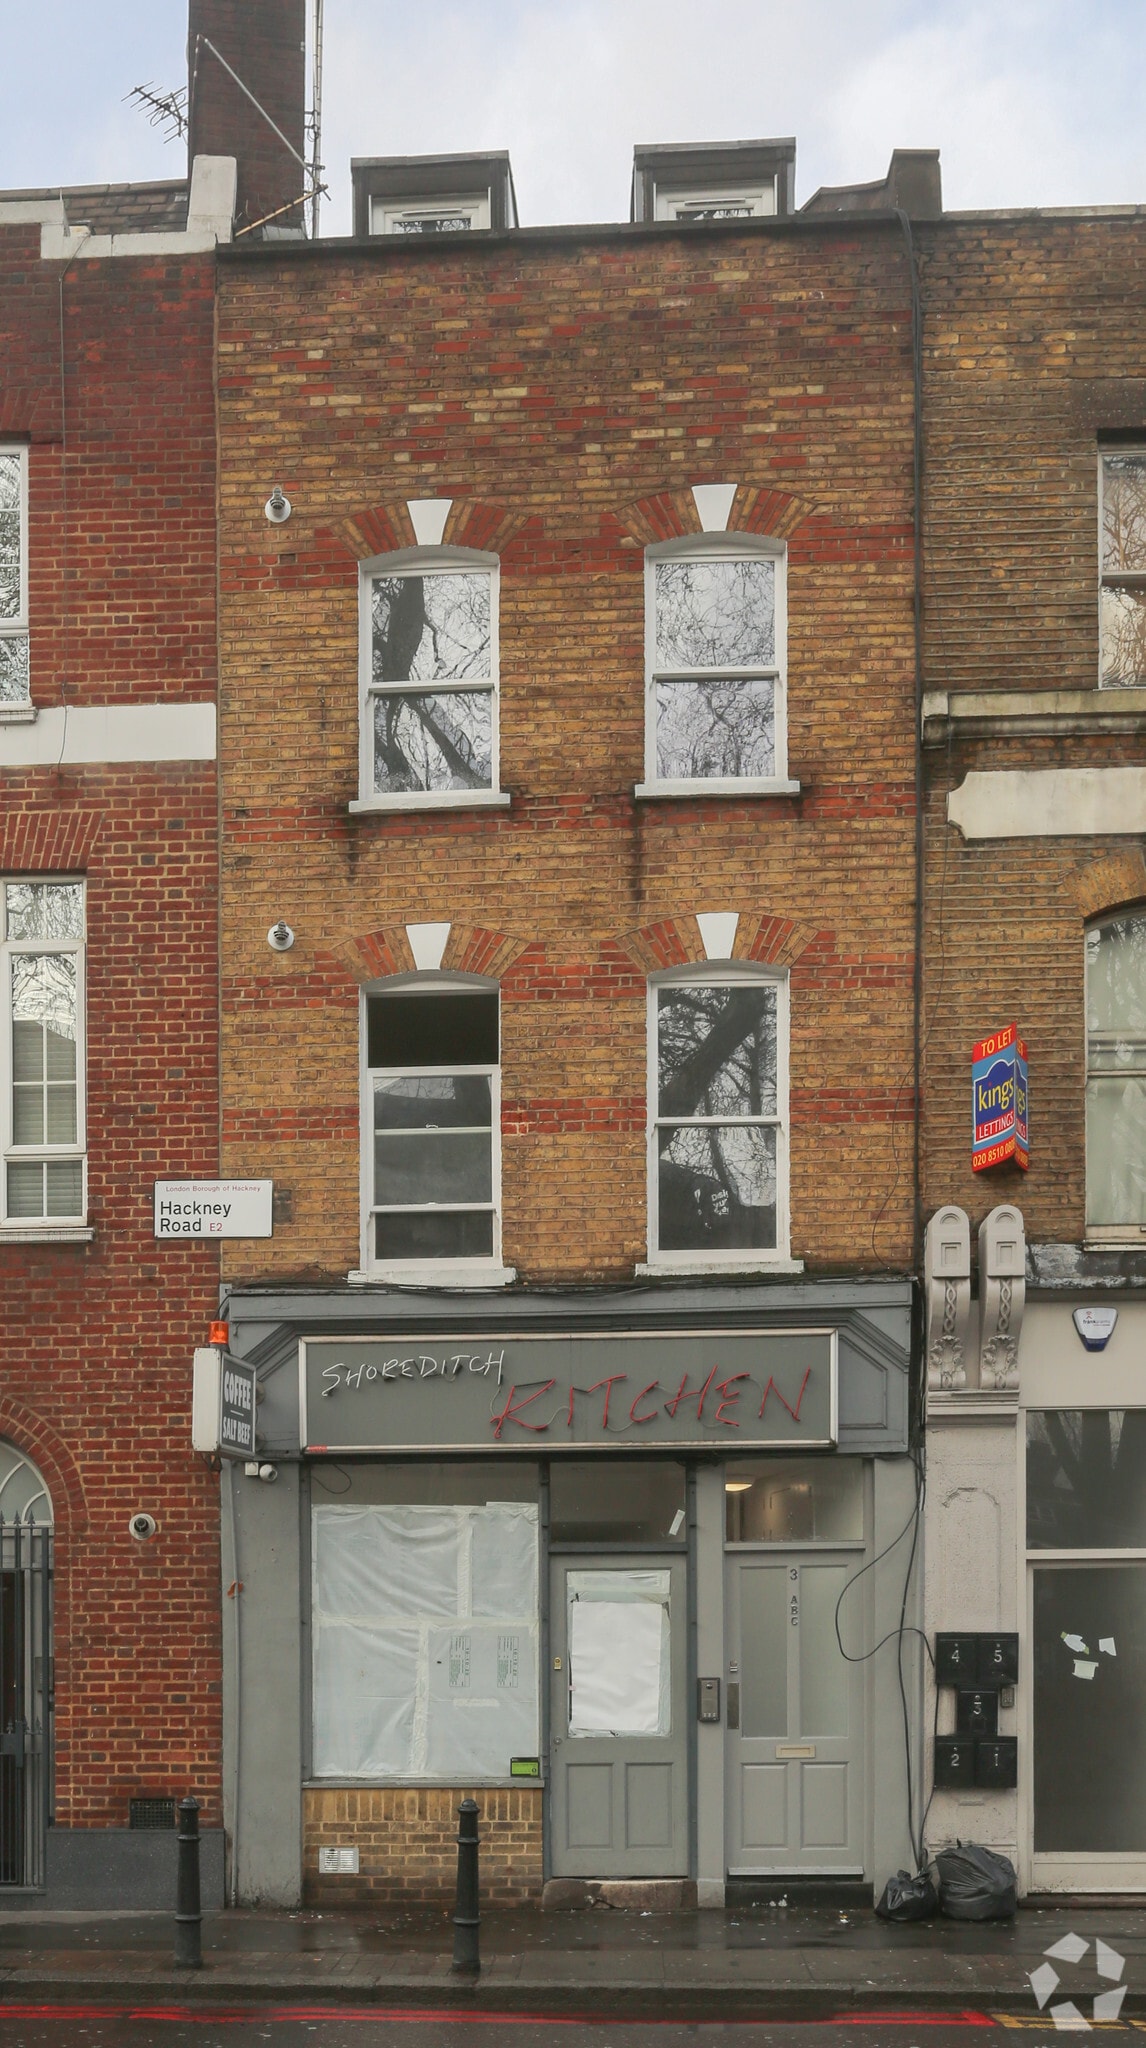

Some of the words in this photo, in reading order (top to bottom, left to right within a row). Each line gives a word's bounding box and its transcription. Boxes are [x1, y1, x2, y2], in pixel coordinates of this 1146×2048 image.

[981, 1039, 995, 1057] TO
[997, 1028, 1013, 1048] LET
[978, 1076, 1014, 1112] kings
[978, 1112, 1014, 1139] LETTINGS
[973, 1152, 987, 1167] 020
[988, 1145, 1005, 1162] 8510
[192, 1185, 220, 1193] Borough
[232, 1185, 261, 1193] Hackney
[160, 1200, 232, 1217] Hackney
[160, 1218, 202, 1232] Road
[209, 1222, 223, 1232] E2
[321, 1350, 505, 1397] SHOREDITCH
[223, 1370, 252, 1410] COFFEE
[489, 1364, 811, 1439] KITCHEN
[222, 1416, 237, 1442] SALT
[237, 1421, 251, 1445] BEEF
[789, 1568, 798, 1581] 3
[951, 1649, 961, 1663] 4
[993, 1649, 1003, 1663] 5
[973, 1701, 982, 1715] 3
[951, 1753, 960, 1767] 2
[993, 1753, 999, 1767] 1
